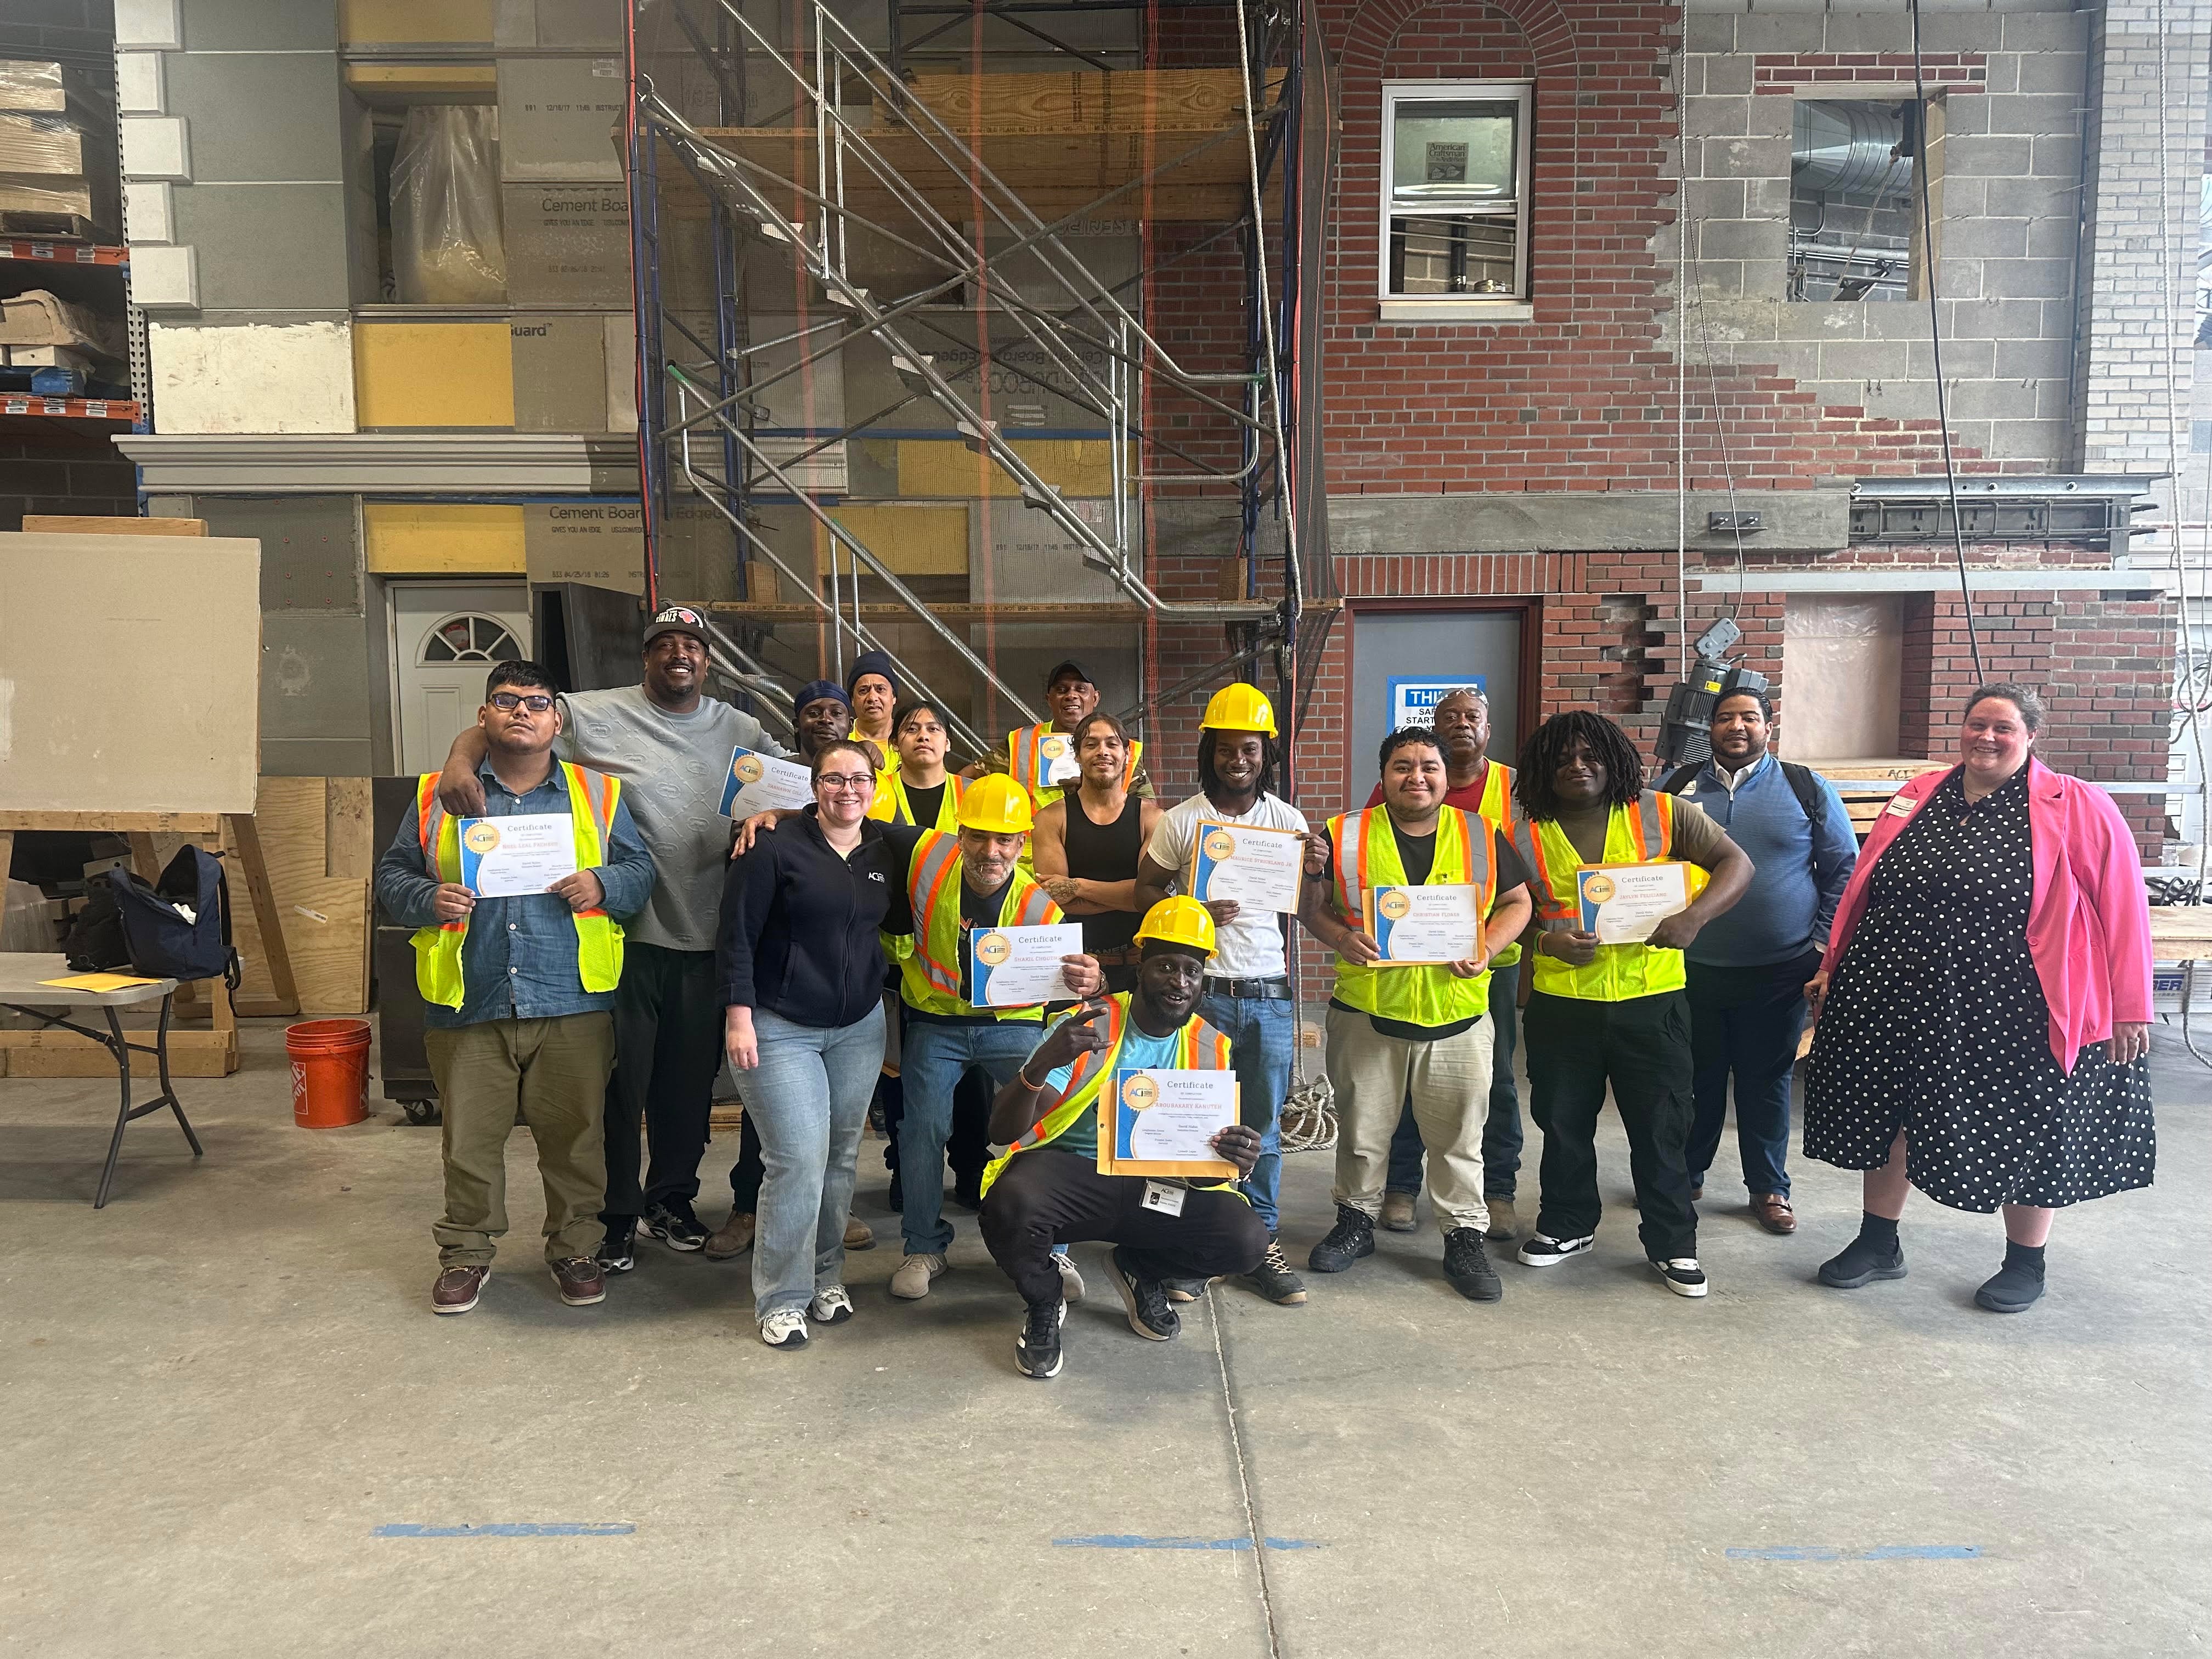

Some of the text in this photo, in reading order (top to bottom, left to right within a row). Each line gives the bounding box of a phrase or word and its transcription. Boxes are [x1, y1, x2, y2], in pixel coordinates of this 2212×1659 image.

[543, 199, 628, 212] Cement Boa
[550, 506, 641, 520] Cement Boar
[1410, 691, 1442, 704] THI
[771, 767, 809, 782] Certificate
[1888, 769, 1912, 780] ACI
[1242, 838, 1283, 849] Certificate
[1254, 859, 1284, 867] STRICKLAND
[1167, 1081, 1214, 1089] Certificate
